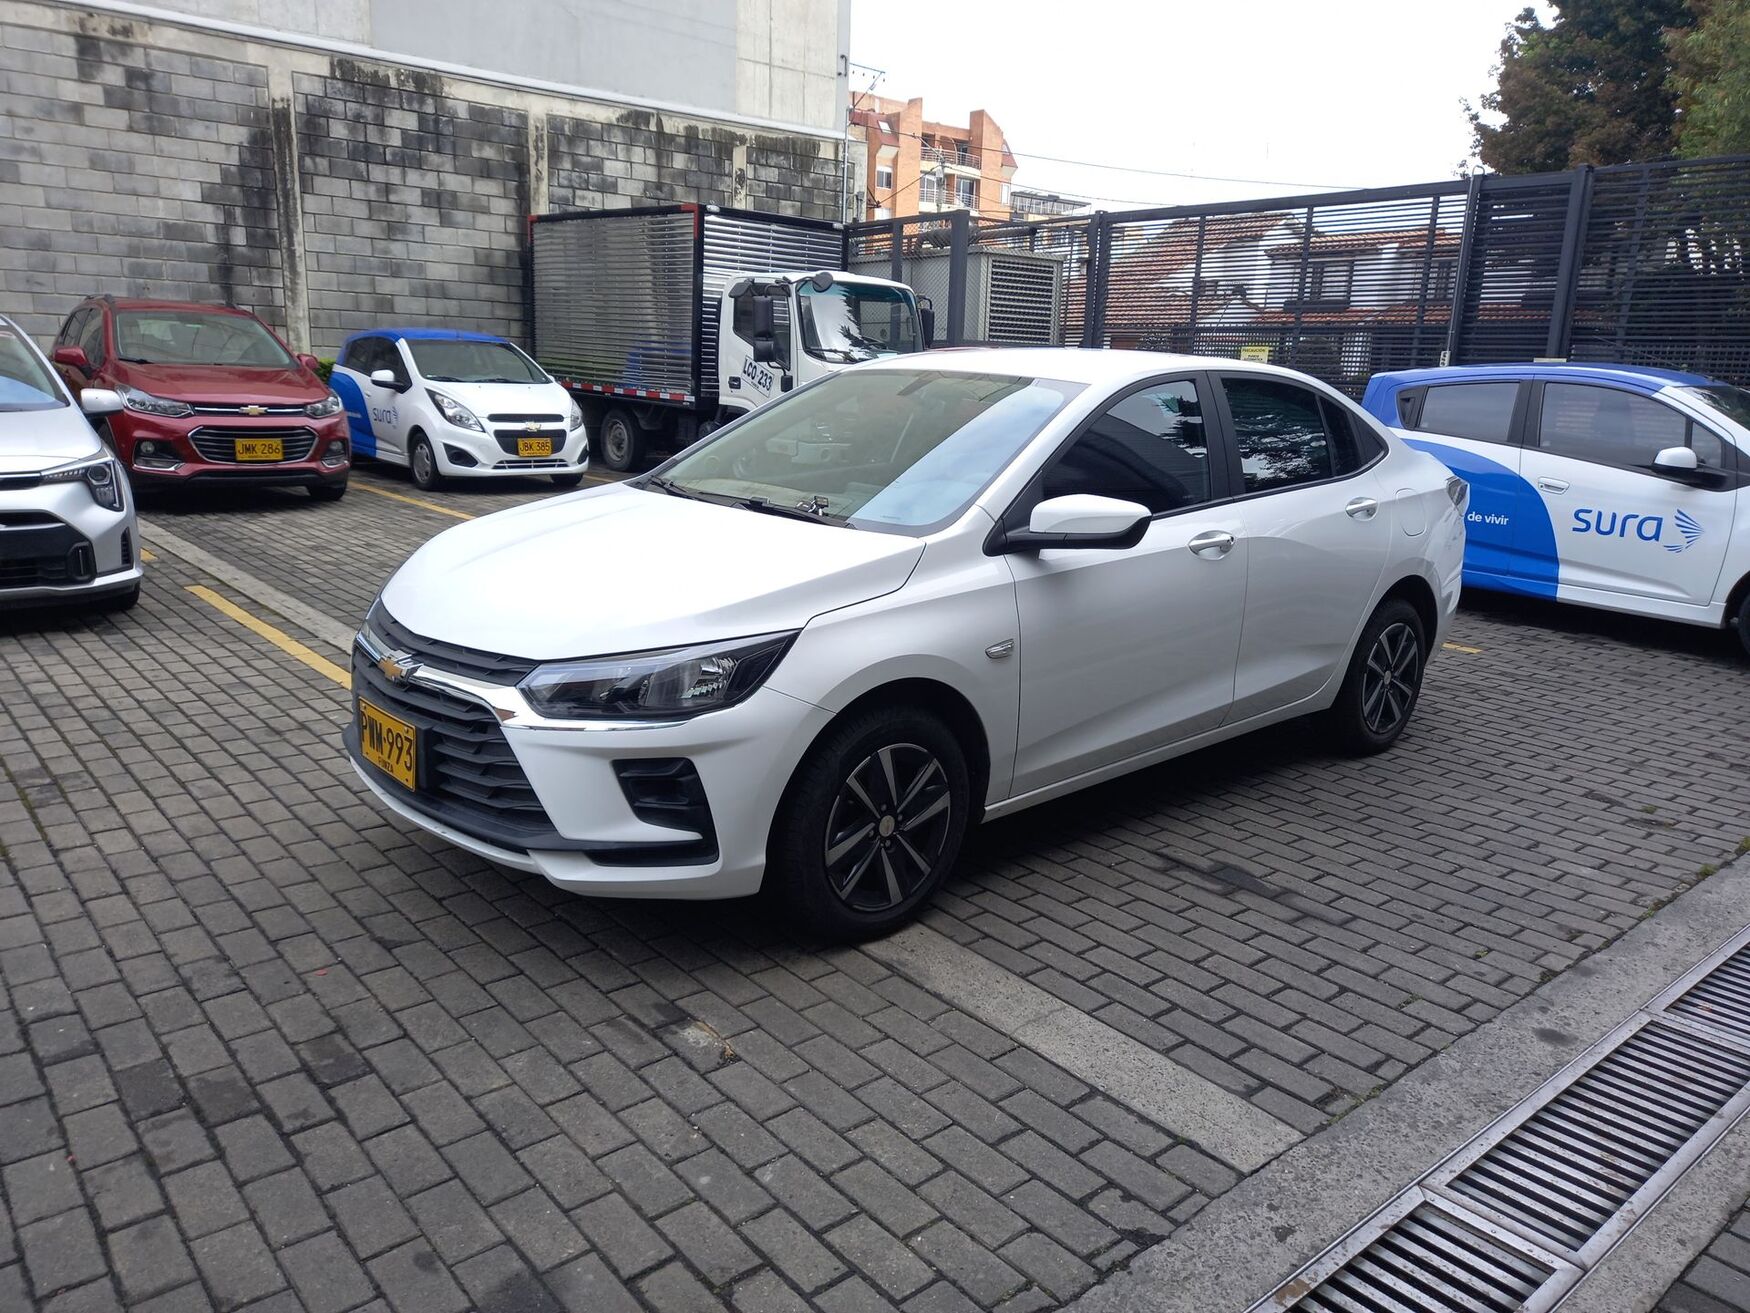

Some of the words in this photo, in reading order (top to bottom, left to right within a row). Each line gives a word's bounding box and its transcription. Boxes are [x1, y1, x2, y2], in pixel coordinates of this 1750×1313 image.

[372, 407, 392, 424] sura
[237, 443, 258, 455] JMK
[261, 443, 281, 455] 286
[519, 441, 534, 452] JBK
[536, 441, 550, 452] 385
[1467, 511, 1483, 522] de
[1484, 513, 1509, 526] vivir
[1571, 507, 1664, 542] sura
